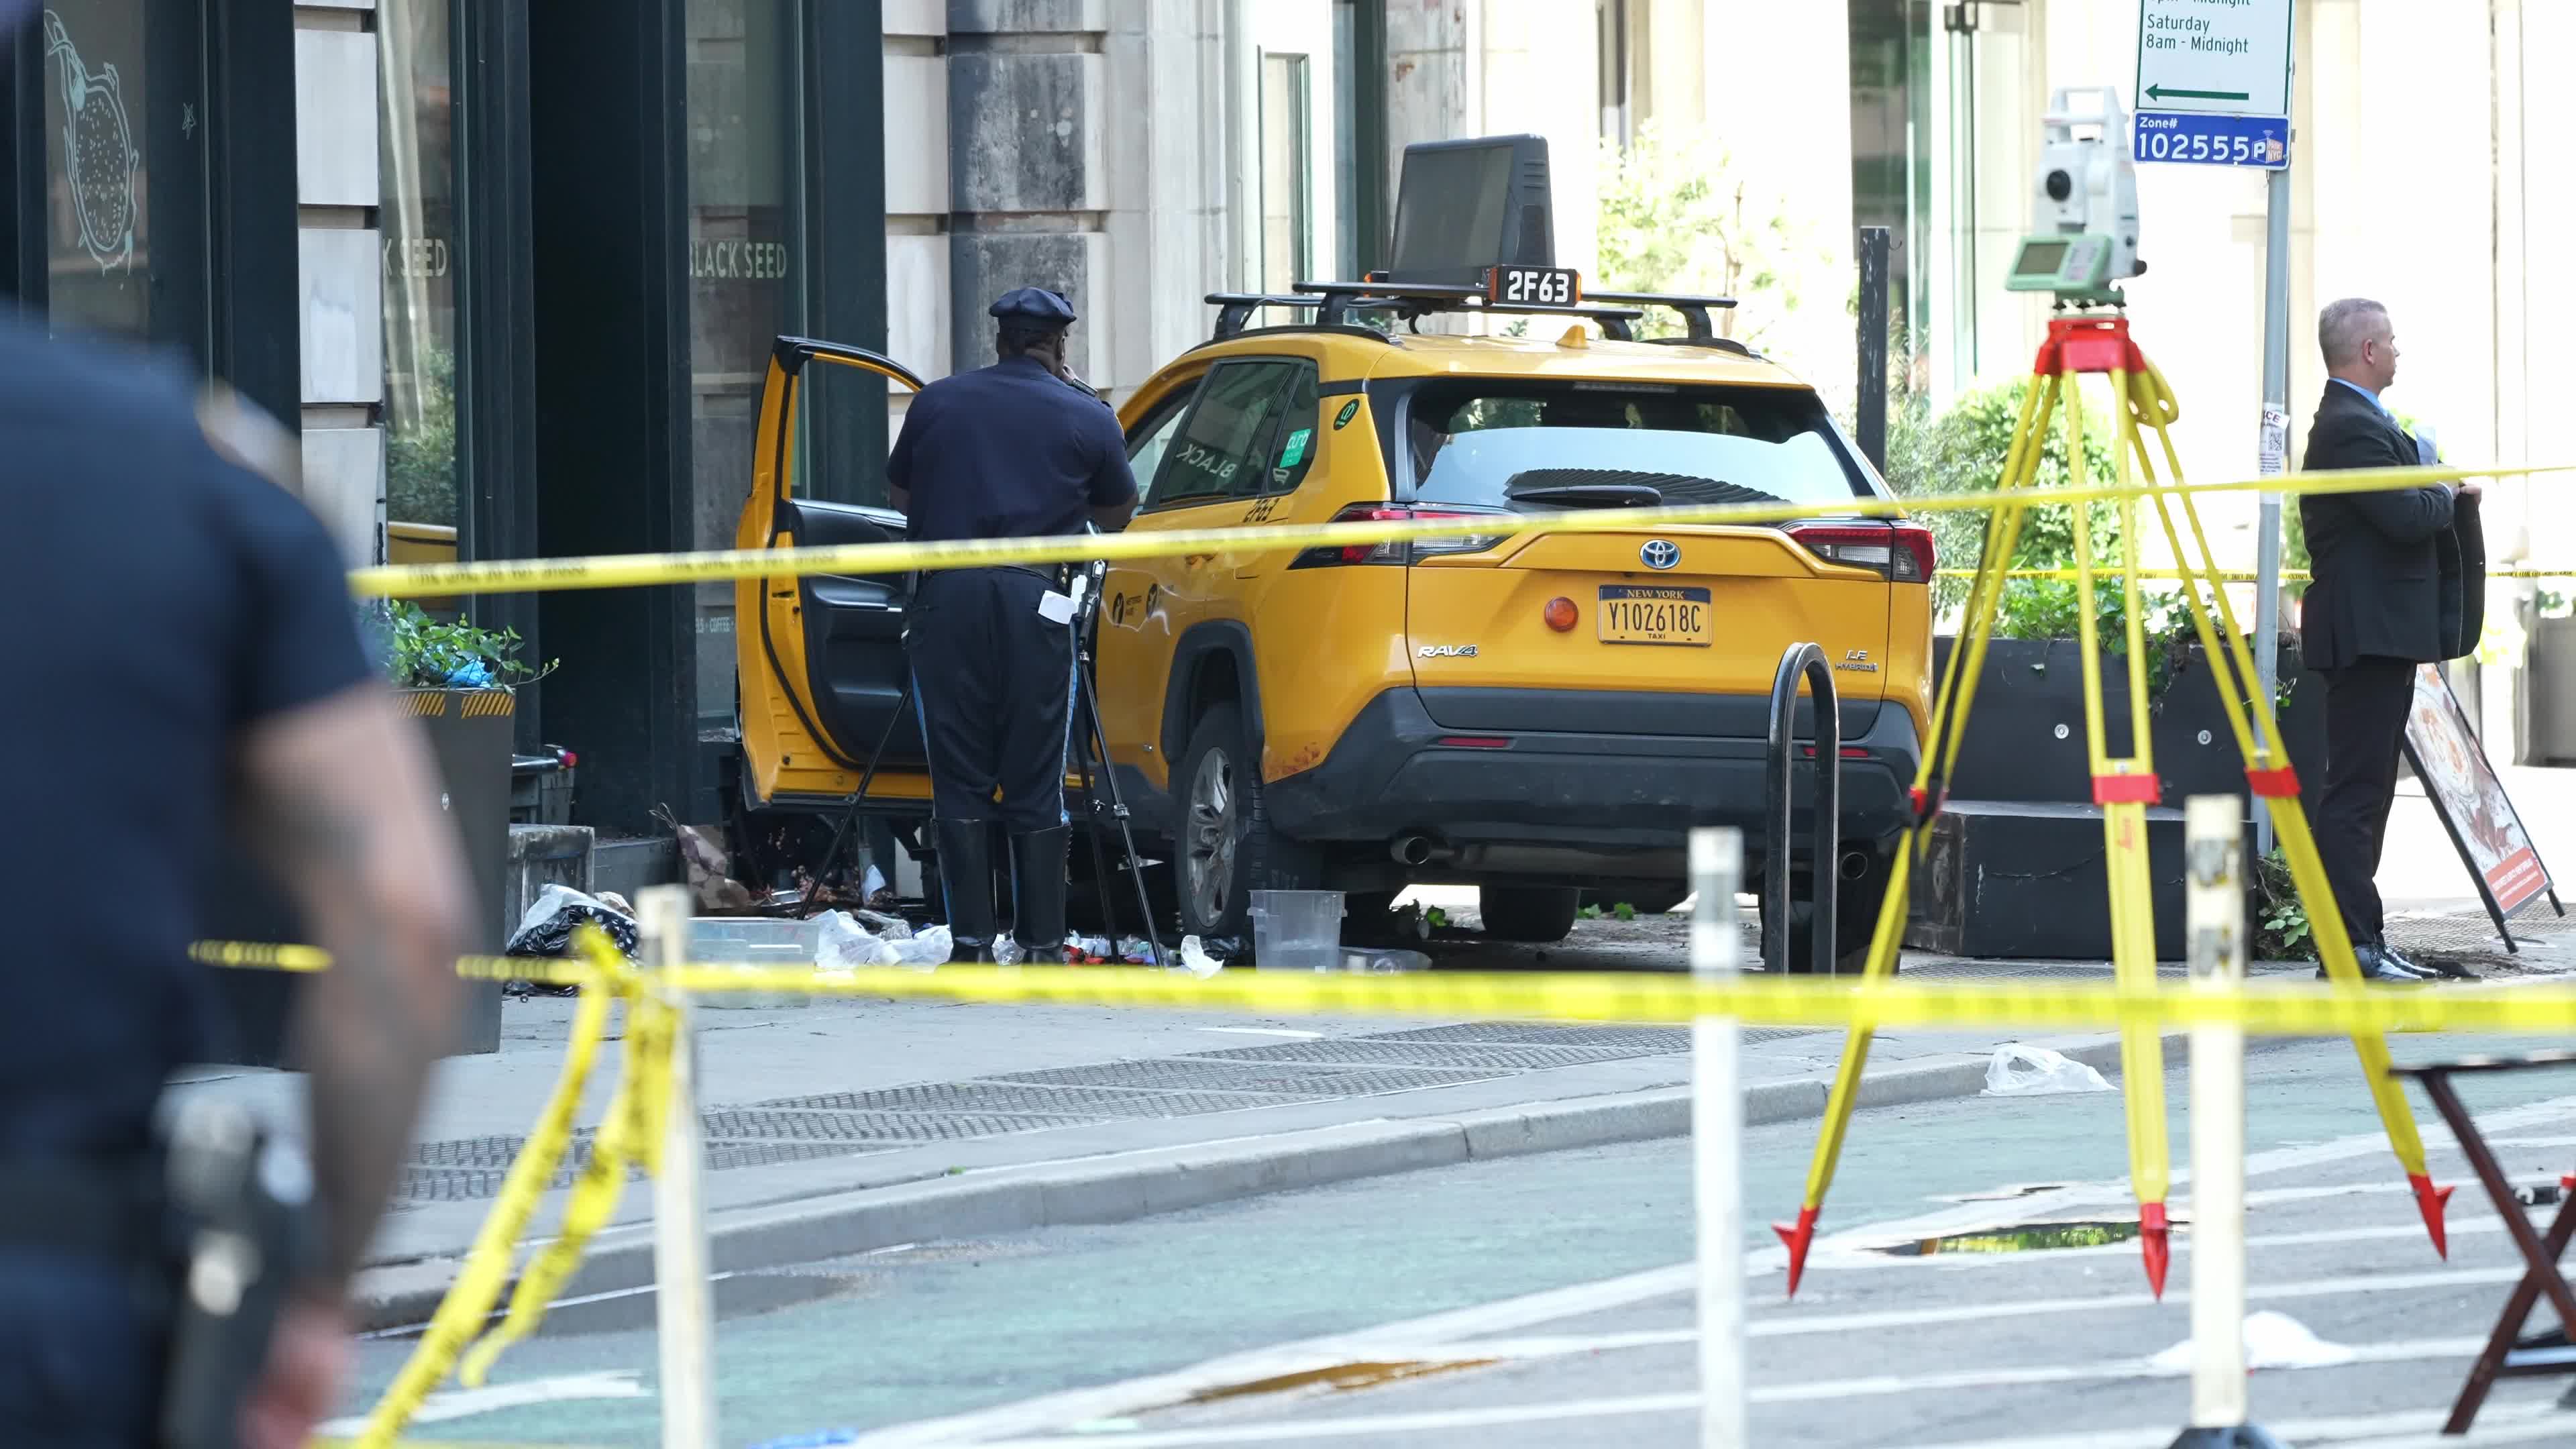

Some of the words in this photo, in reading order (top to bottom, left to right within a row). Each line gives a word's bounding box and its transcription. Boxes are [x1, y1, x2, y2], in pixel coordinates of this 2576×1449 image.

[2147, 13, 2210, 34] Saturday
[2146, 34, 2176, 49] 8am
[2191, 36, 2249, 56] Midnight
[2139, 117, 2178, 129] Zone#
[2139, 133, 2249, 162] 102555
[400, 238, 447, 276] SEED
[745, 242, 786, 278] SEED
[1507, 270, 1570, 303] 2F63
[1627, 590, 1653, 598] NEW
[1657, 590, 1686, 599] YORK
[1609, 602, 1701, 633] Y102618C
[1417, 644, 1479, 658] RAV4
[1845, 649, 1868, 660] LE
